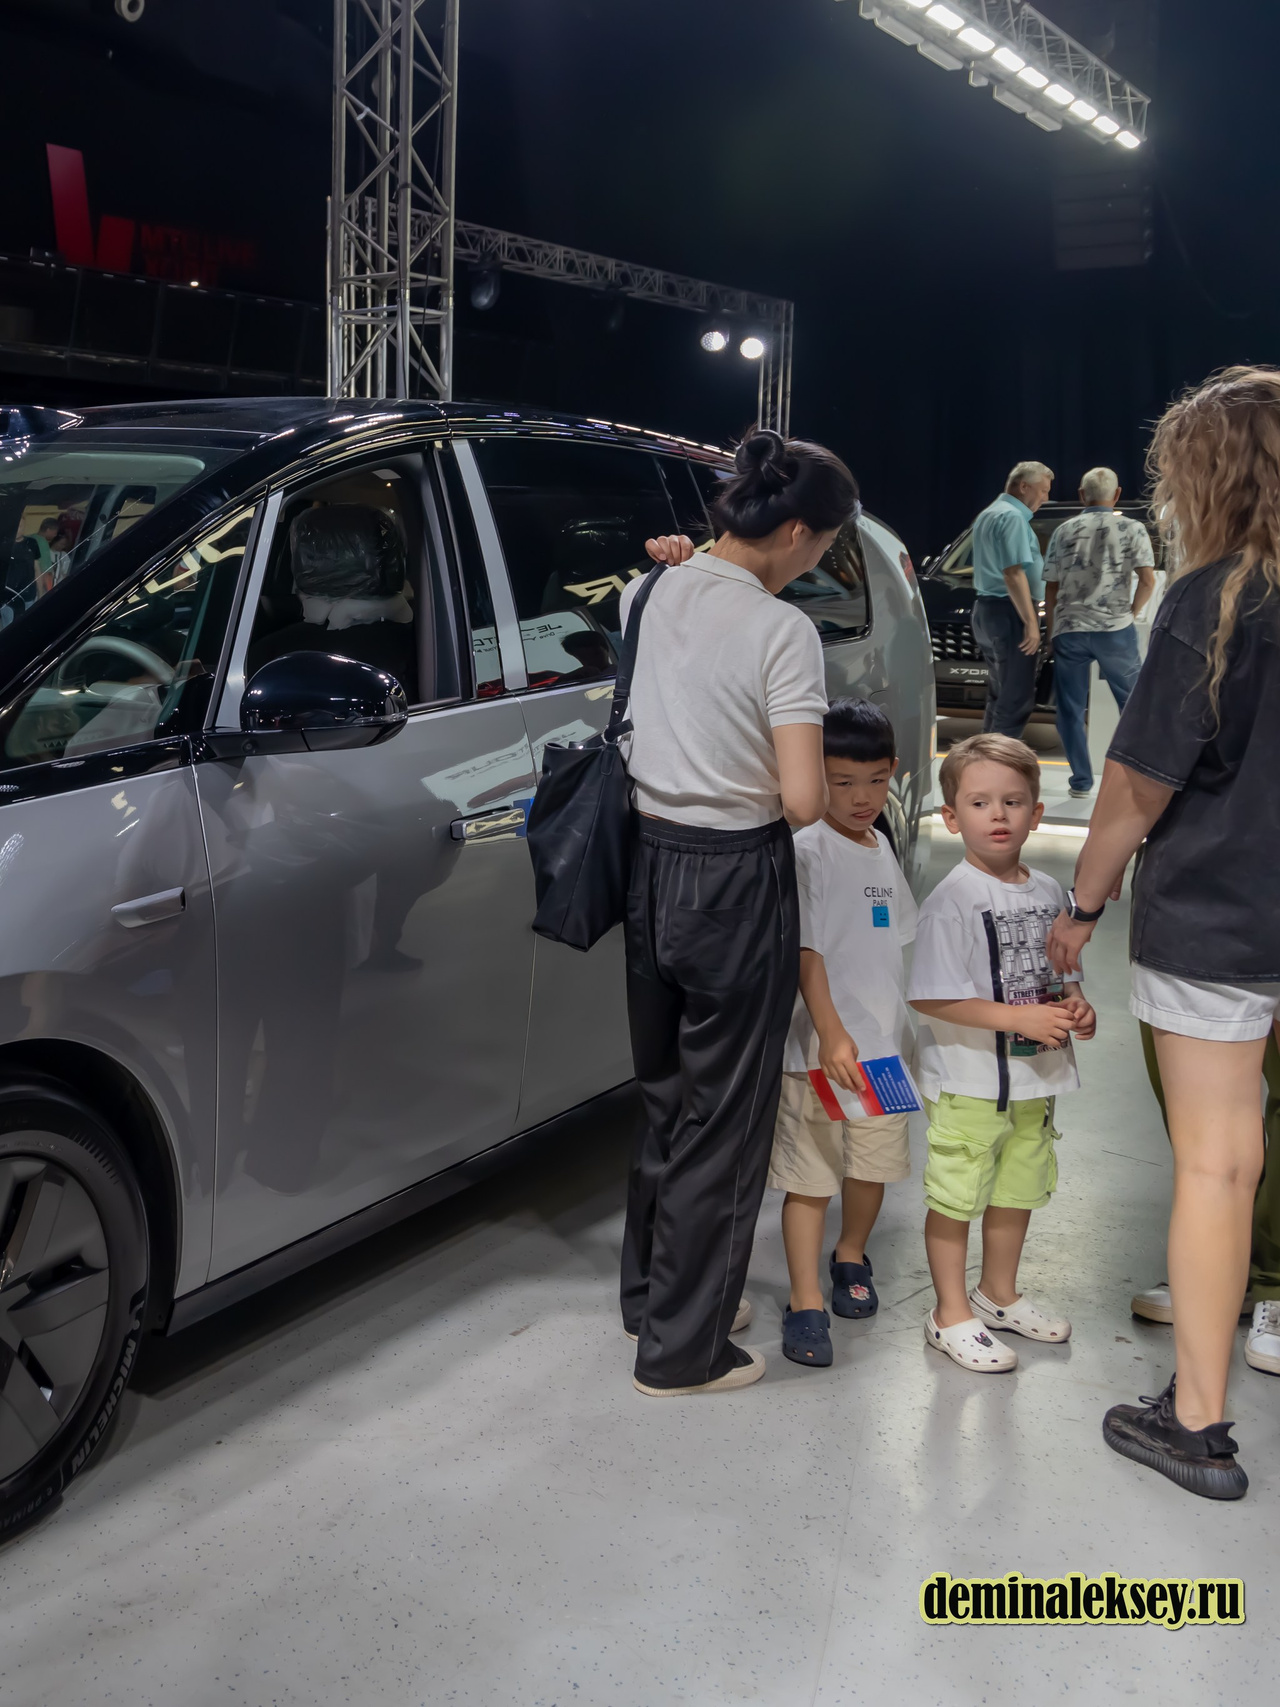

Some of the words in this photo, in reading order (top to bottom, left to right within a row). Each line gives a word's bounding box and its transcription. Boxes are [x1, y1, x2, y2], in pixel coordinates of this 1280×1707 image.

[950, 667, 980, 676] X70
[863, 886, 893, 898] CELINE
[1013, 989, 1034, 999] STREET
[72, 1338, 137, 1475] MICHELIN
